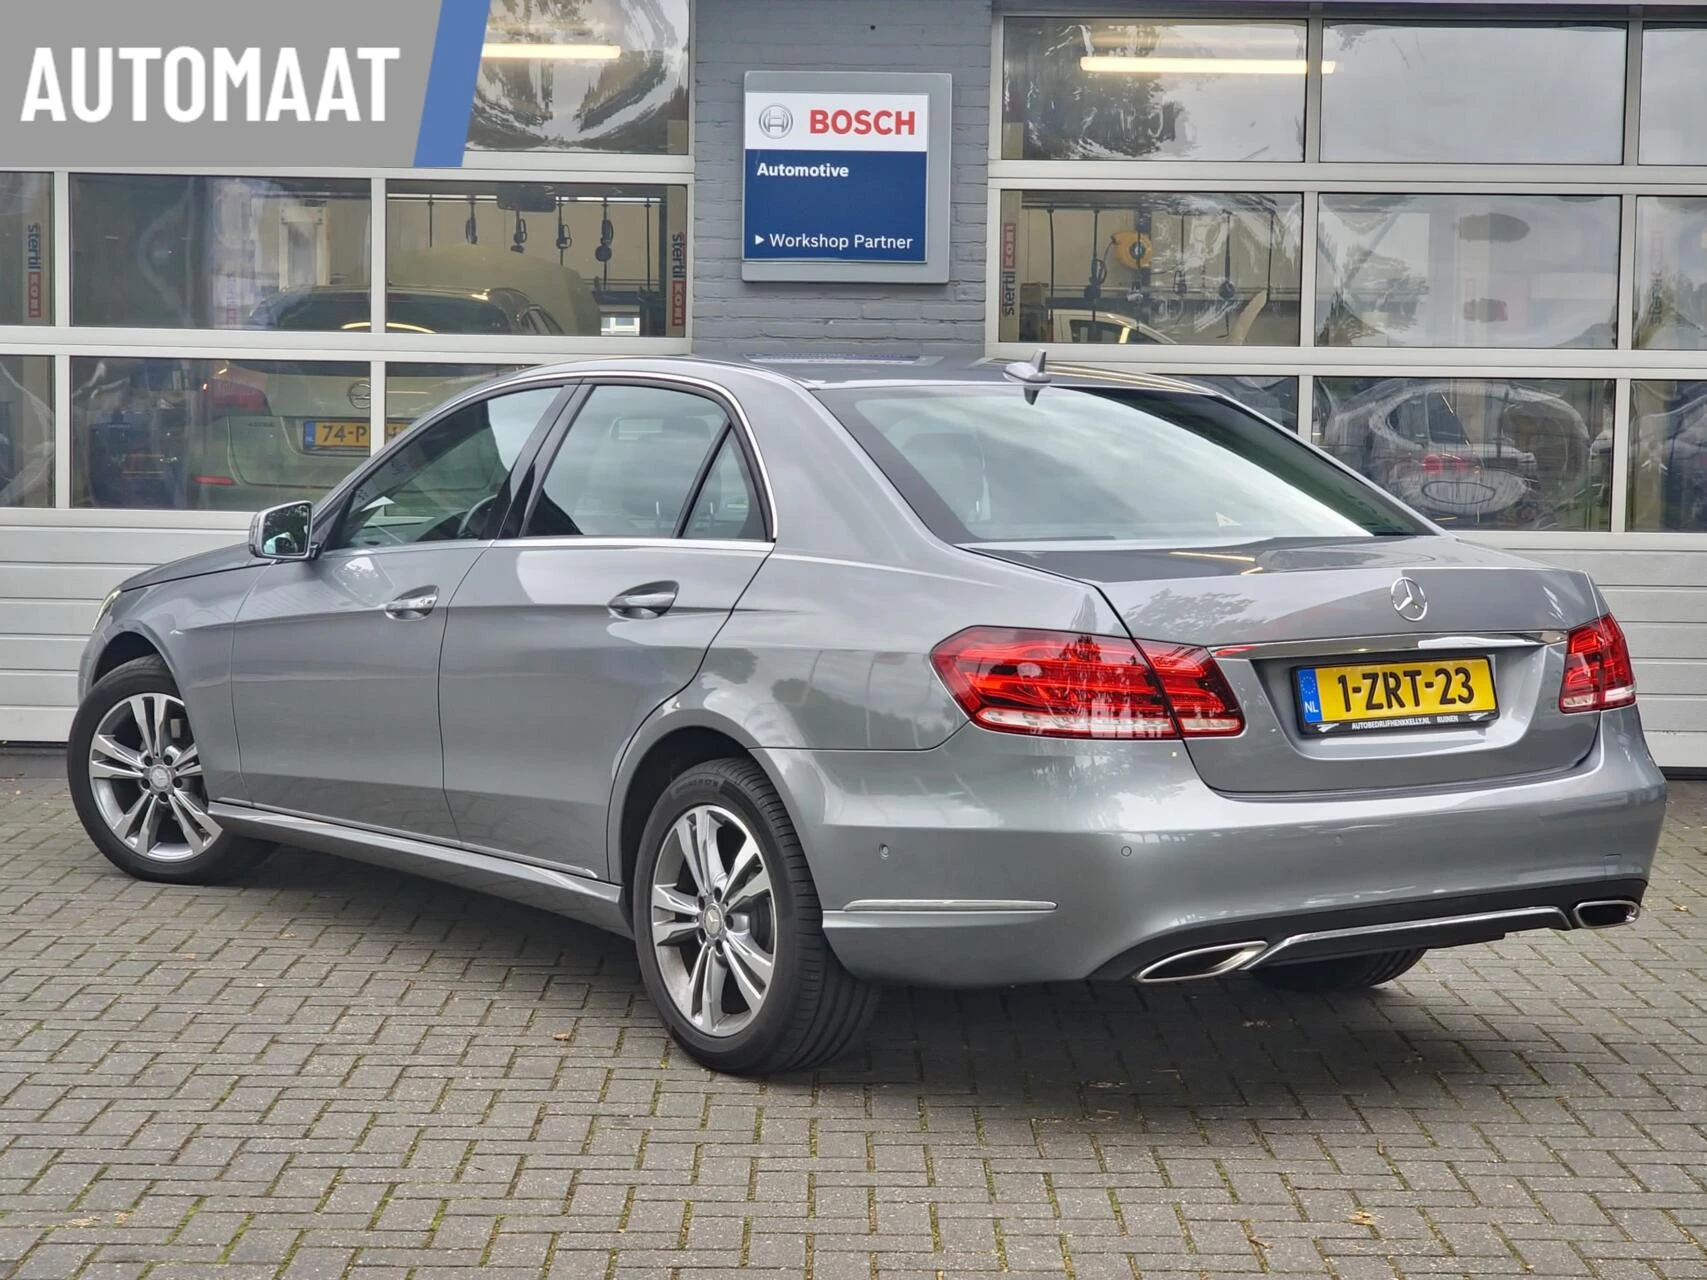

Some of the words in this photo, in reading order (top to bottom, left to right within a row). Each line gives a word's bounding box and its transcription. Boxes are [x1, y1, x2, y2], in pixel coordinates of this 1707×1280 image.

[810, 109, 916, 136] BOSCH
[757, 163, 849, 178] Automotive
[28, 225, 41, 269] stertil
[672, 234, 687, 279] stertil
[769, 234, 848, 251] Workshop
[854, 234, 913, 249] Partner
[1002, 270, 1015, 316] stertil
[1304, 700, 1319, 714] NL
[1337, 666, 1475, 713] 1-ZRT-23
